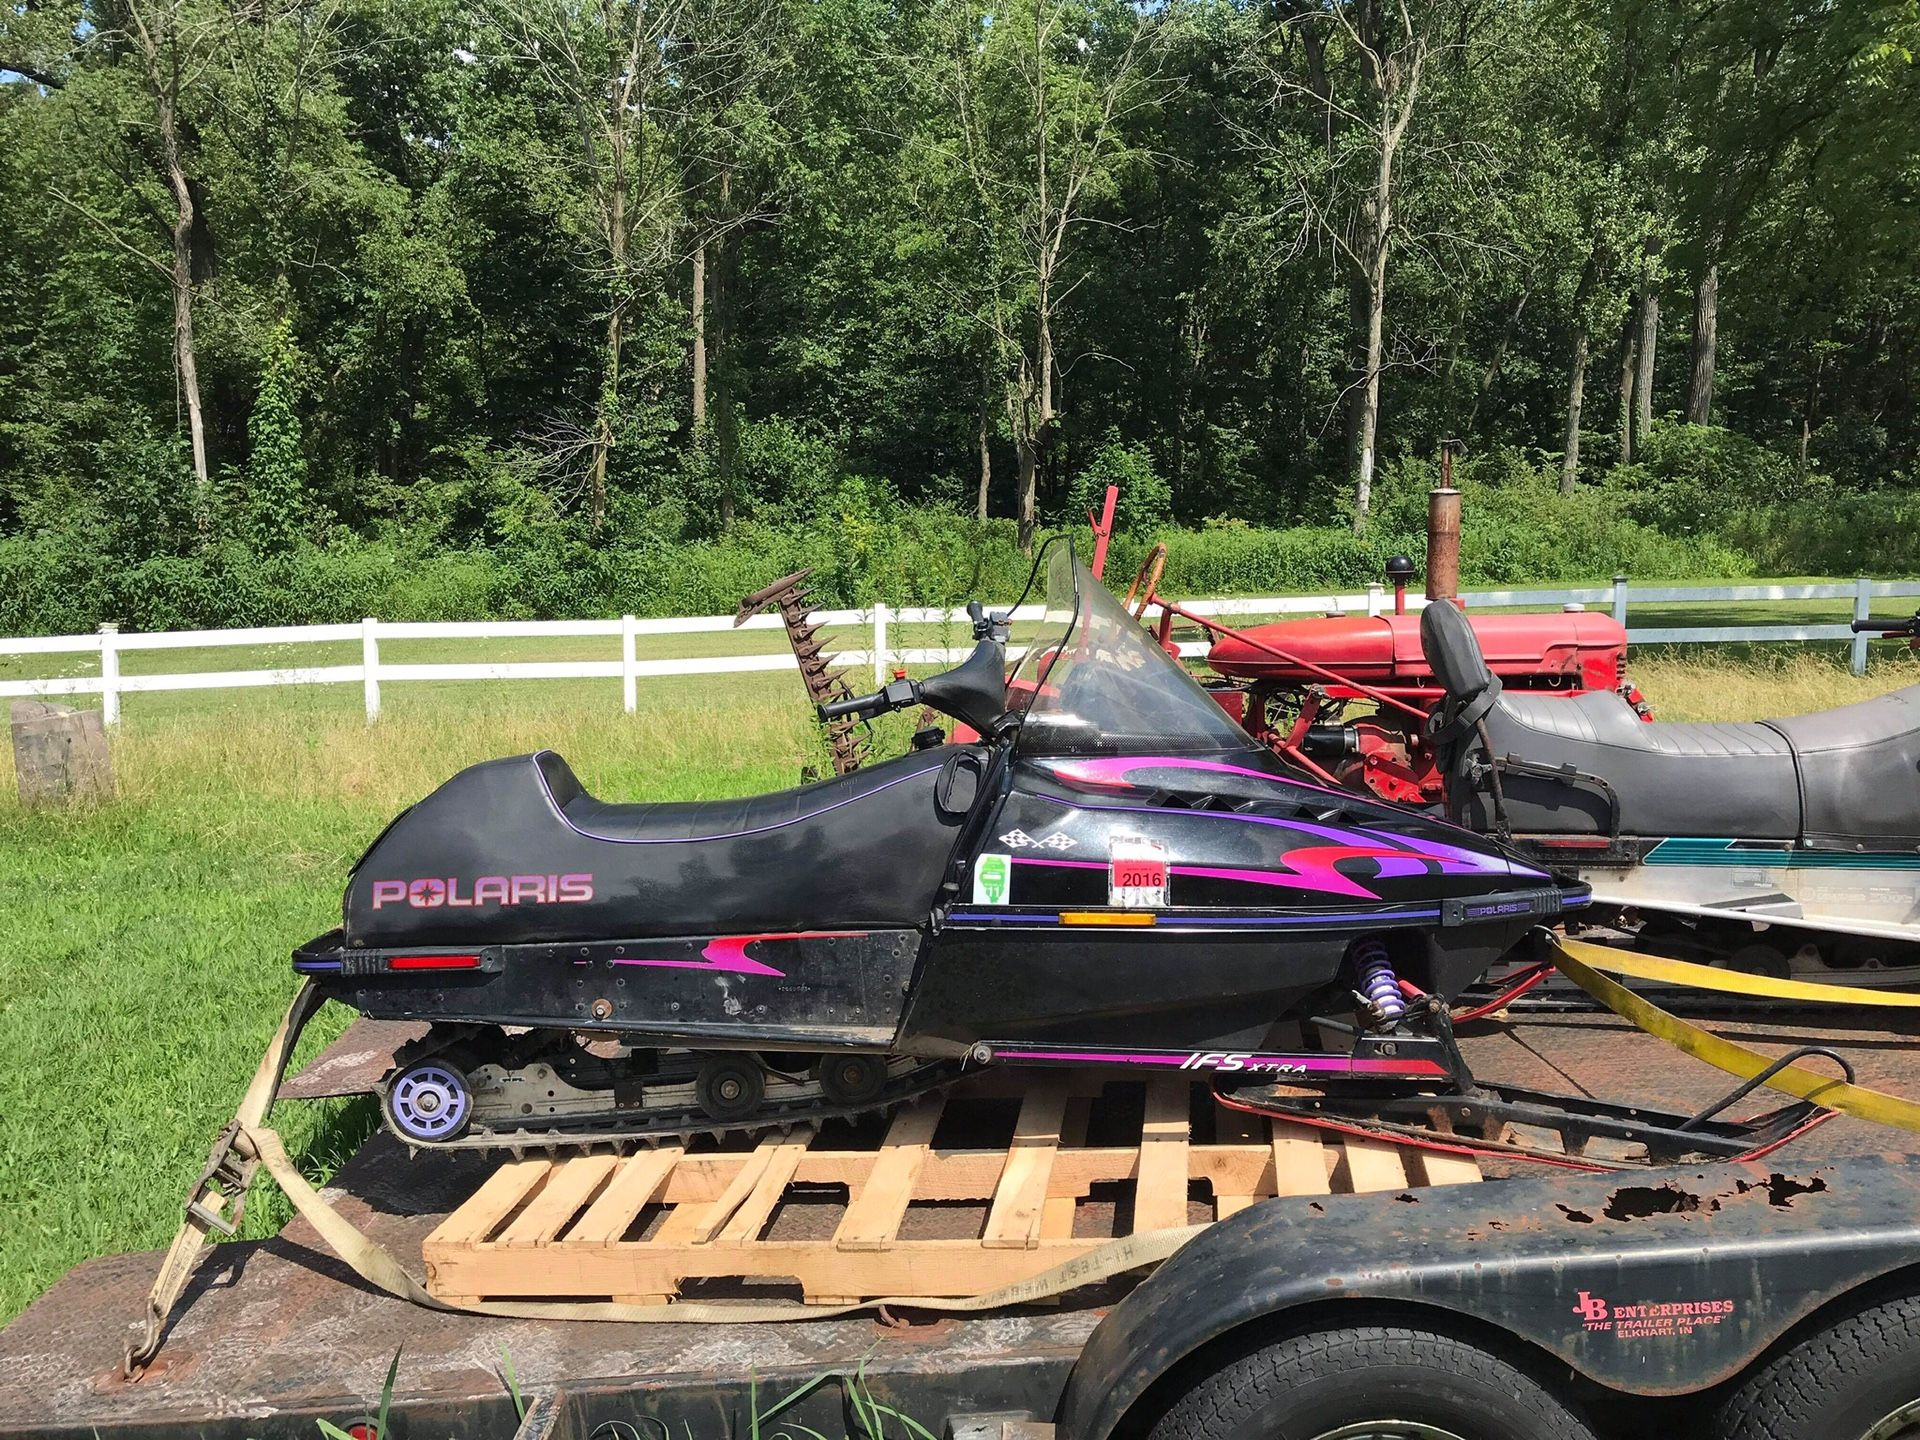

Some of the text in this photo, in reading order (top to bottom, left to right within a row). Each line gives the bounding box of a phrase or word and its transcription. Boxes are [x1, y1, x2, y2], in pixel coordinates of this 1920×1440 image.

[1122, 872, 1161, 887] 2016
[372, 873, 594, 911] POLARIS
[1480, 904, 1518, 915] POLARIS
[1179, 1052, 1306, 1073] IFS XTRA
[1572, 1291, 1734, 1321] JB ENTERPRISES
[1616, 1318, 1673, 1329] TRAILER
[1681, 1326, 1693, 1334] IN
